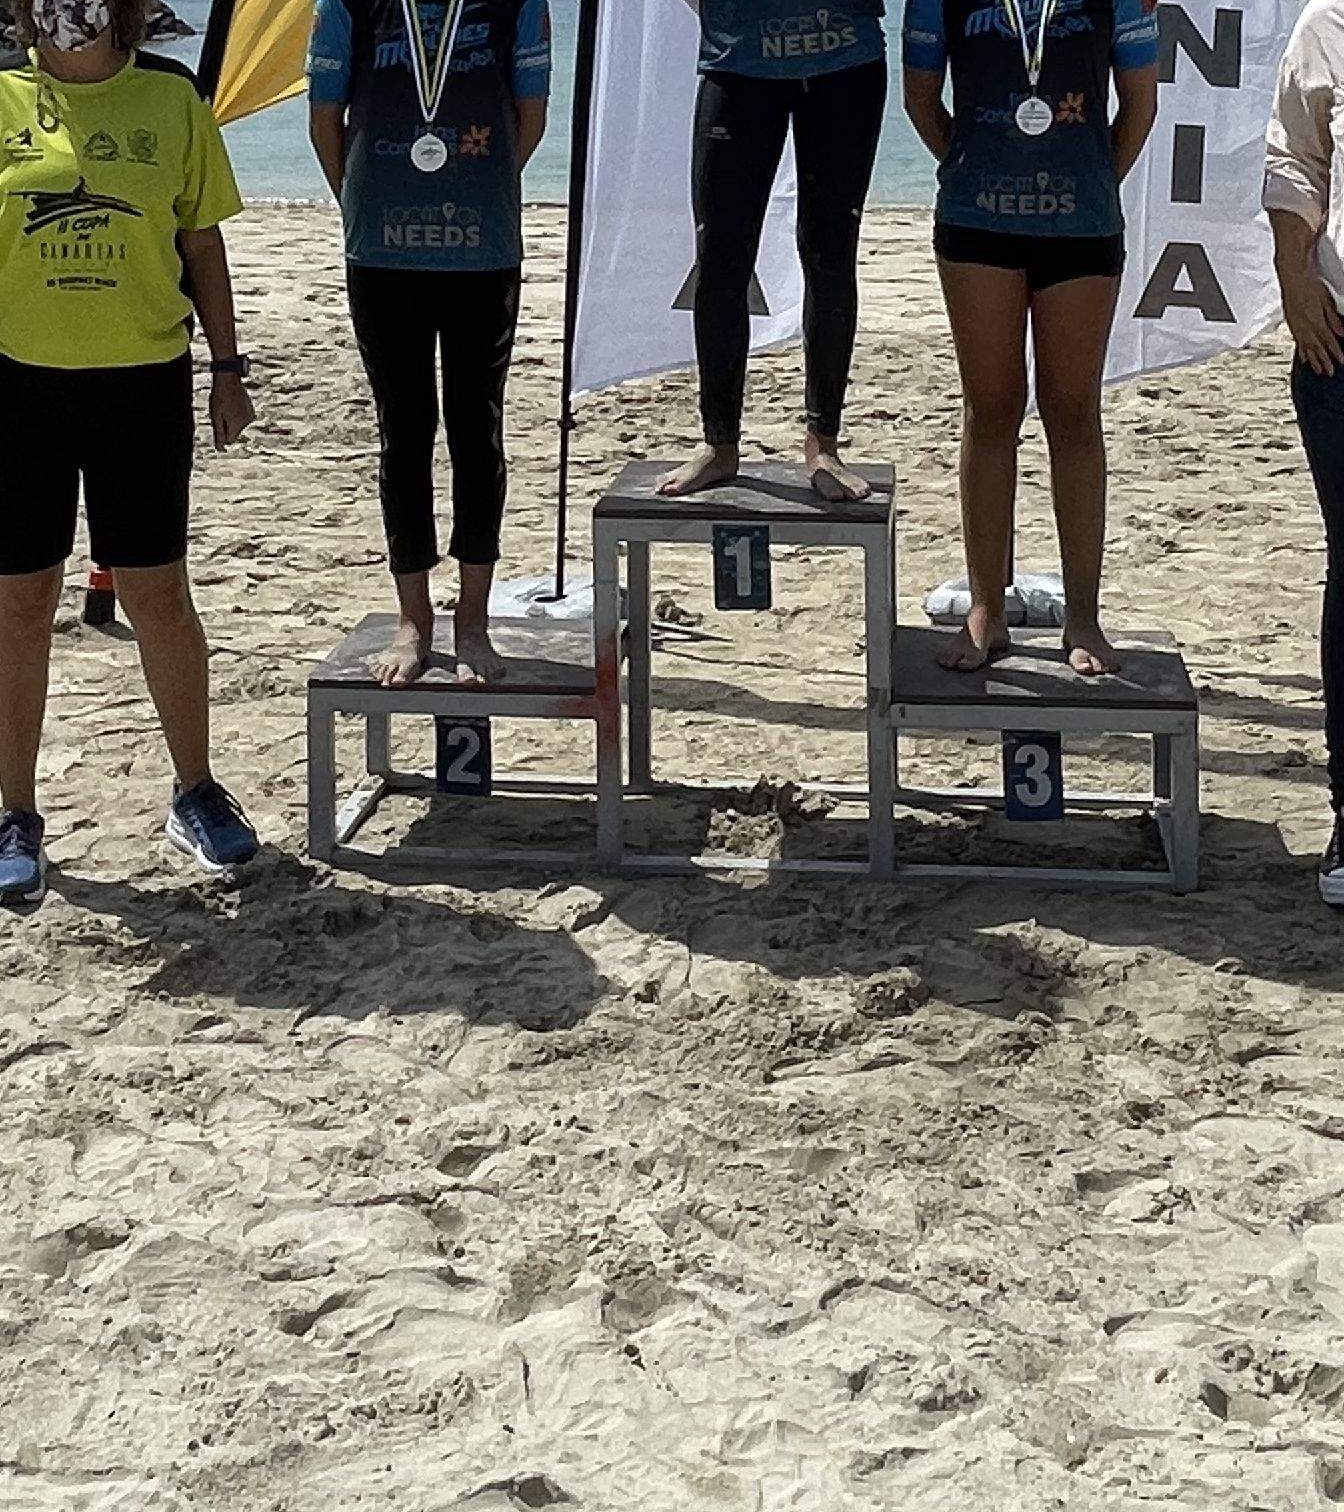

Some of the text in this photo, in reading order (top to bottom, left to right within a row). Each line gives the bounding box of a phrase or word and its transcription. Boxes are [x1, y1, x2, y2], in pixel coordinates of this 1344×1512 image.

[761, 26, 857, 59] NEEDS
[383, 224, 481, 248] NEEDS
[724, 534, 754, 598] 1
[446, 725, 481, 787] 2
[1016, 742, 1054, 810] 3
